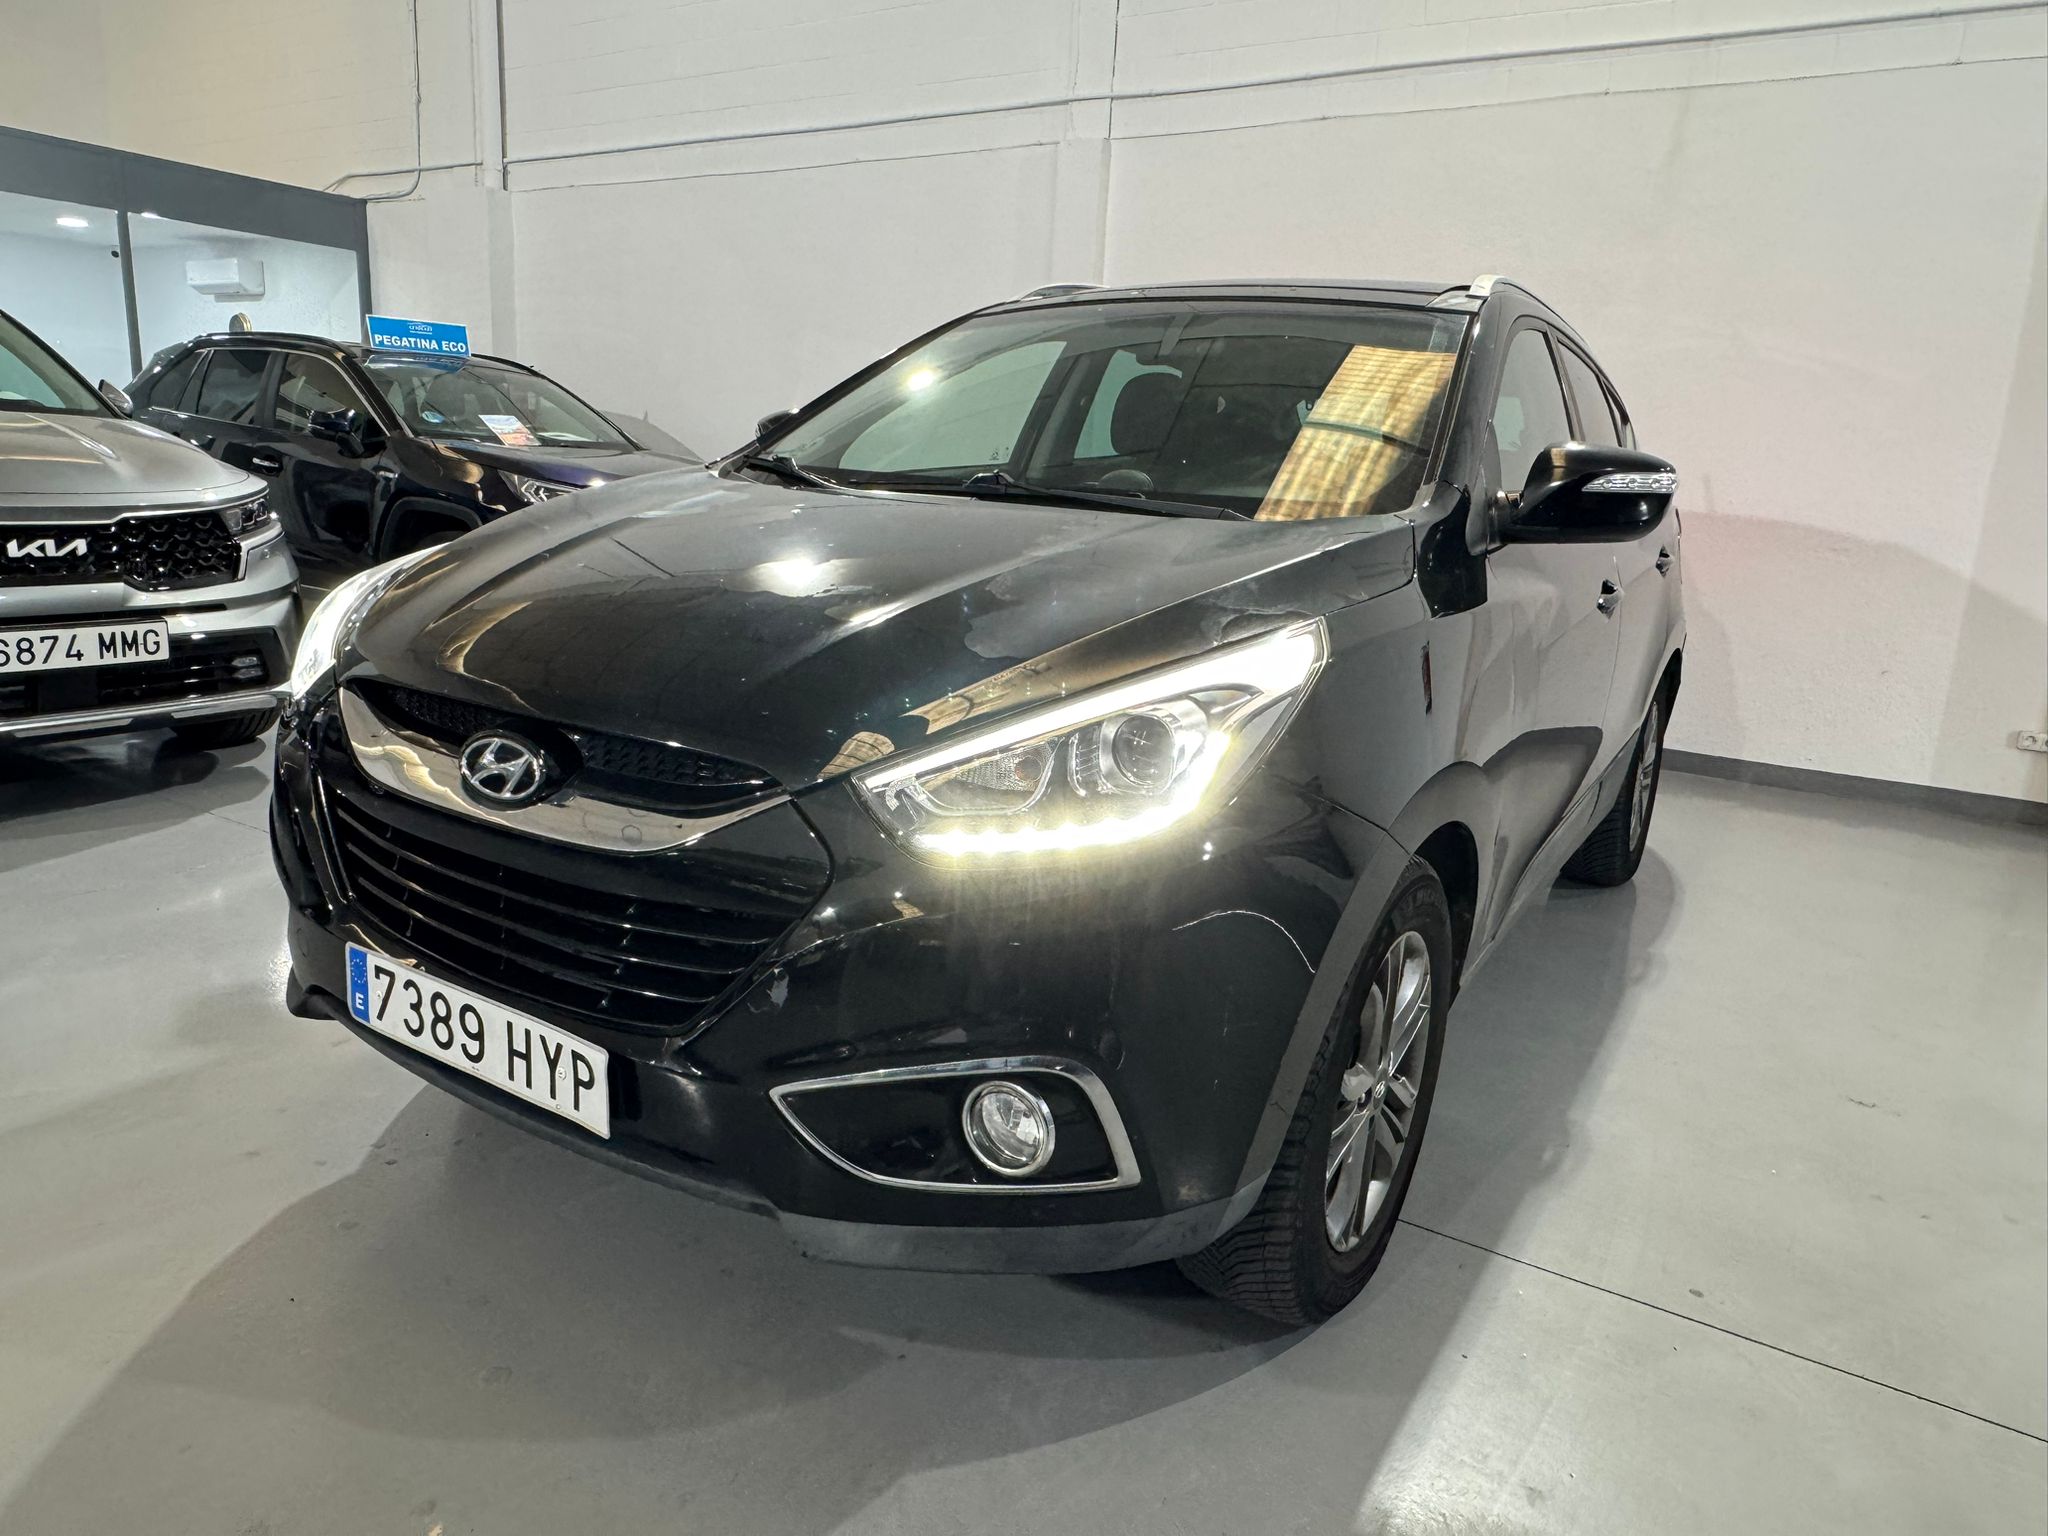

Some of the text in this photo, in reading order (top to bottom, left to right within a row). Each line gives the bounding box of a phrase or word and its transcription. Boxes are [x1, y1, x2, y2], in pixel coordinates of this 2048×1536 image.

[374, 334, 466, 353] PEGATINA ECO
[98, 629, 161, 659] MMG
[355, 992, 365, 1010] E
[374, 964, 595, 1112] 7389 HYP
